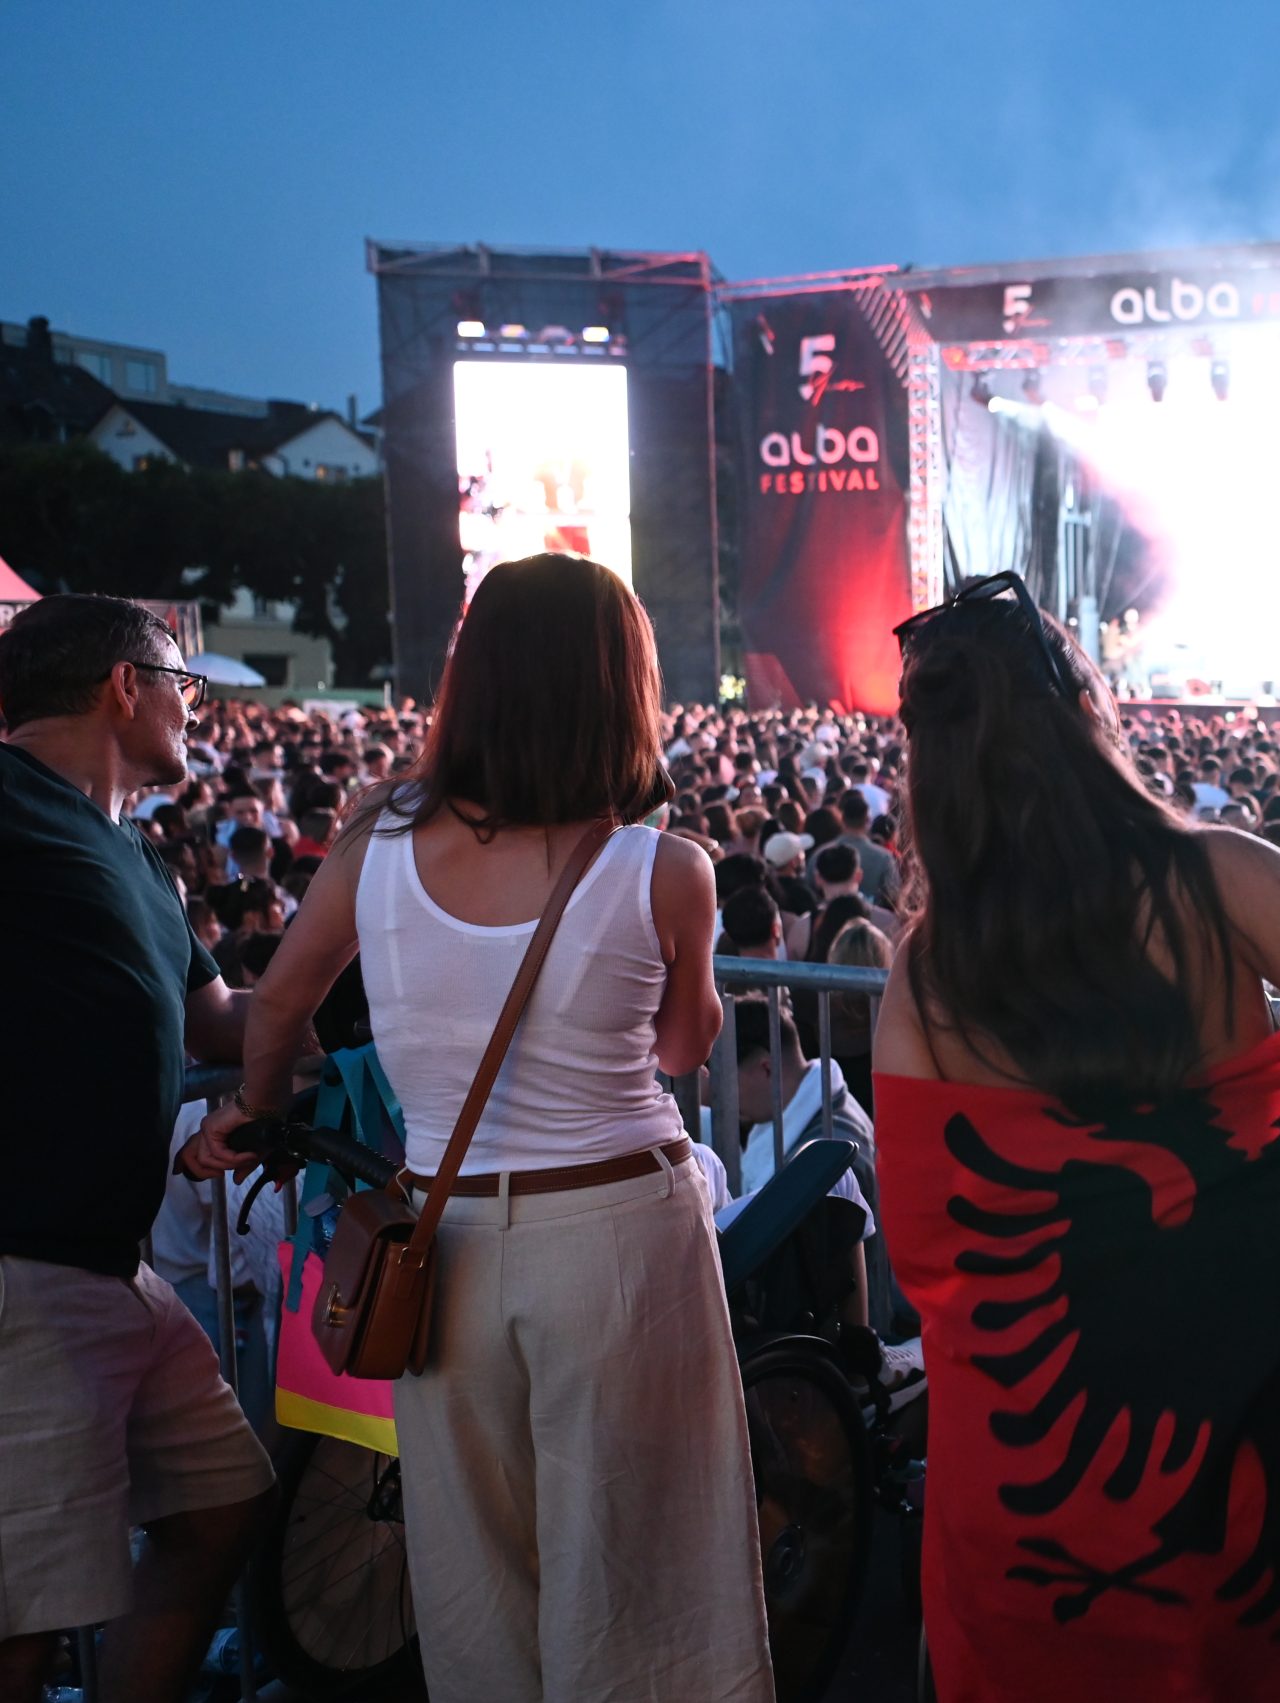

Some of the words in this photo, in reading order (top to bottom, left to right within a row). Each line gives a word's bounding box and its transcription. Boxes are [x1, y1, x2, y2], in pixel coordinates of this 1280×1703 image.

[1003, 284, 1032, 333] 5
[1110, 277, 1240, 325] alba
[799, 333, 837, 401] 5
[760, 423, 880, 467] alba
[760, 468, 880, 495] FESTIVAL
